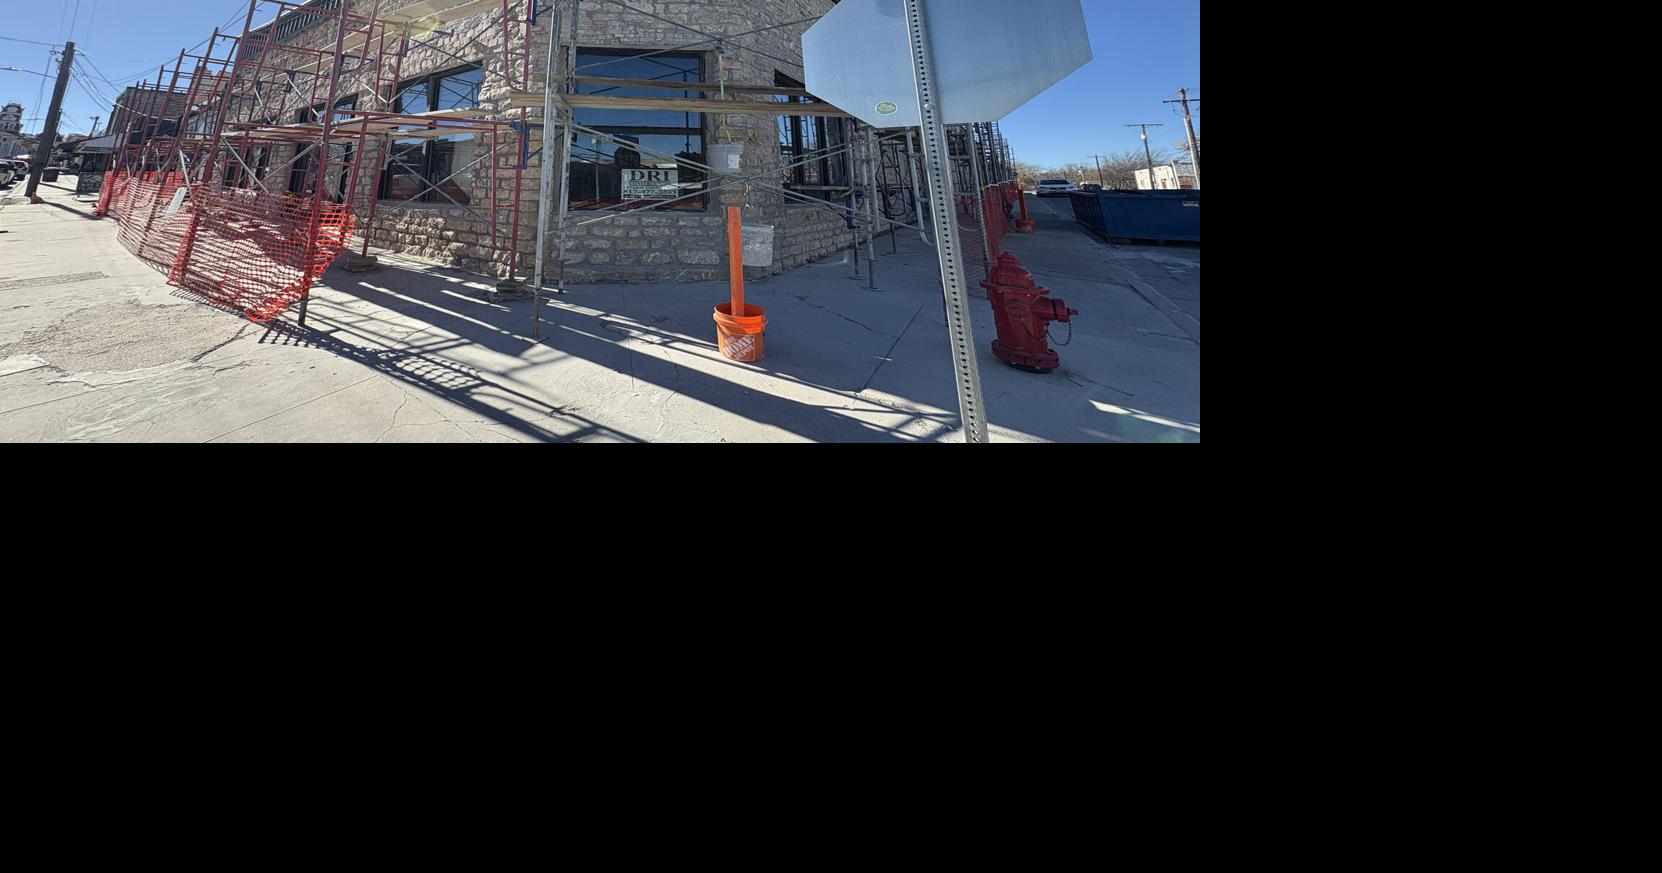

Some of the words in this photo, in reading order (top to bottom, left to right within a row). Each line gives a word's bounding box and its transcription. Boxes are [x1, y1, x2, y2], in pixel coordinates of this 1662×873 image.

[631, 171, 669, 181] DRI
[723, 334, 754, 357] HOME
[733, 345, 754, 359] DEPOT
